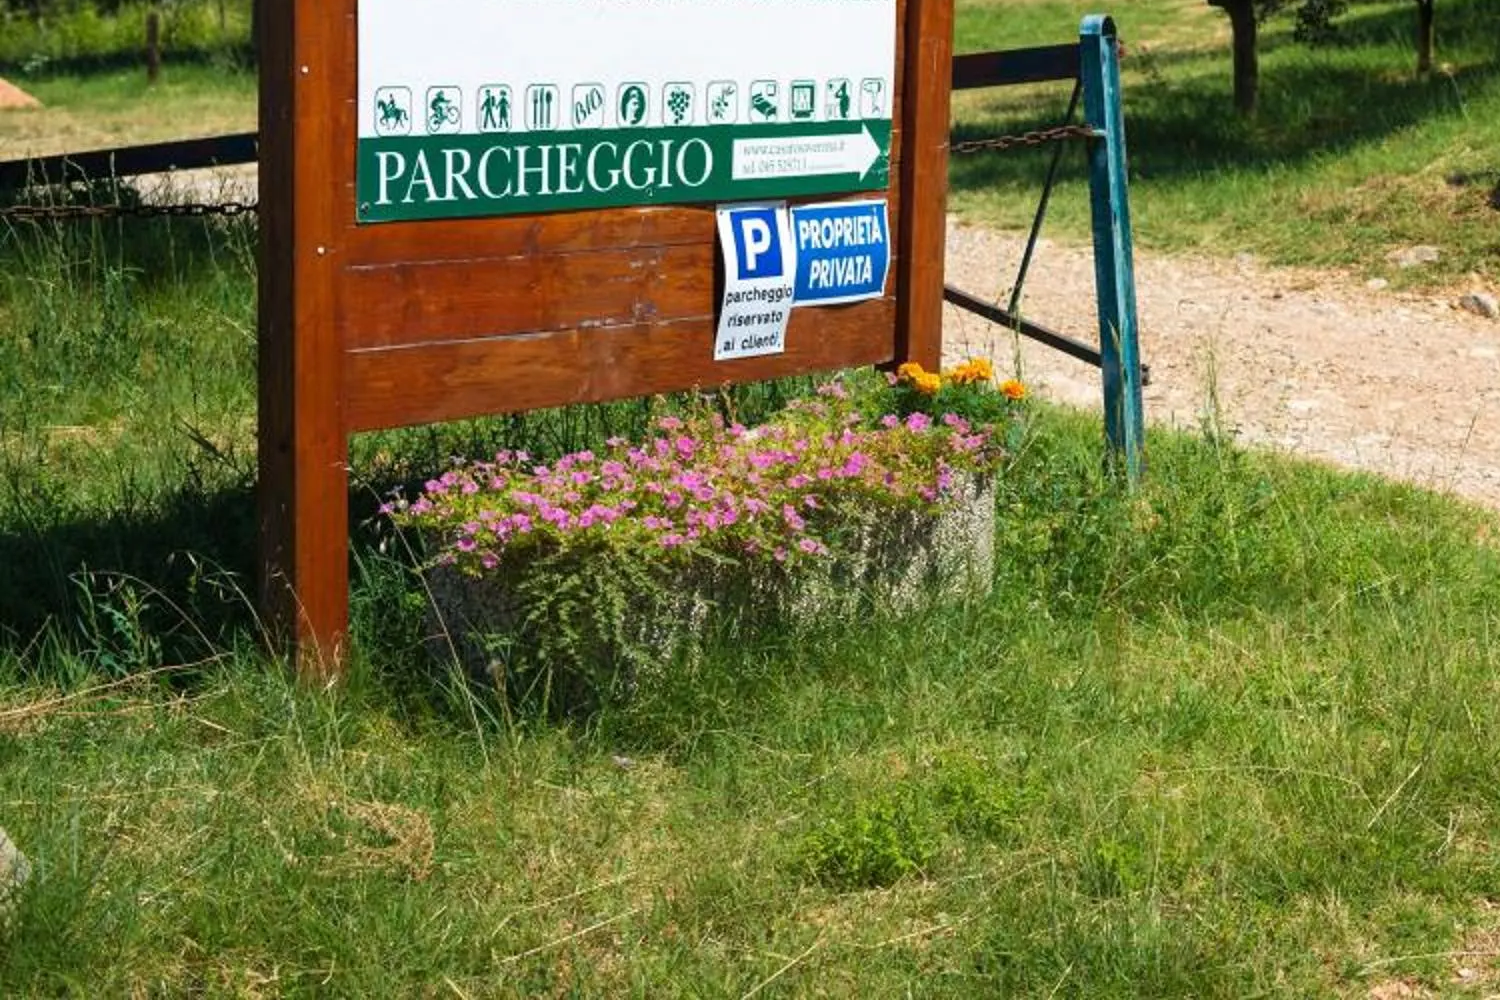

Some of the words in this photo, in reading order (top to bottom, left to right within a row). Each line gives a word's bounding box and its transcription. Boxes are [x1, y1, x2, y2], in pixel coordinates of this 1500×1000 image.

[575, 87, 603, 125] BIO
[374, 137, 714, 206] PARCHEGGIO
[741, 217, 771, 271] P
[797, 207, 883, 250] PROPRIETÀ
[808, 254, 873, 290] PRIVATA
[725, 283, 793, 307] parcheggio
[727, 309, 783, 328] riservato
[723, 336, 735, 352] ai
[741, 330, 779, 350] clienti
